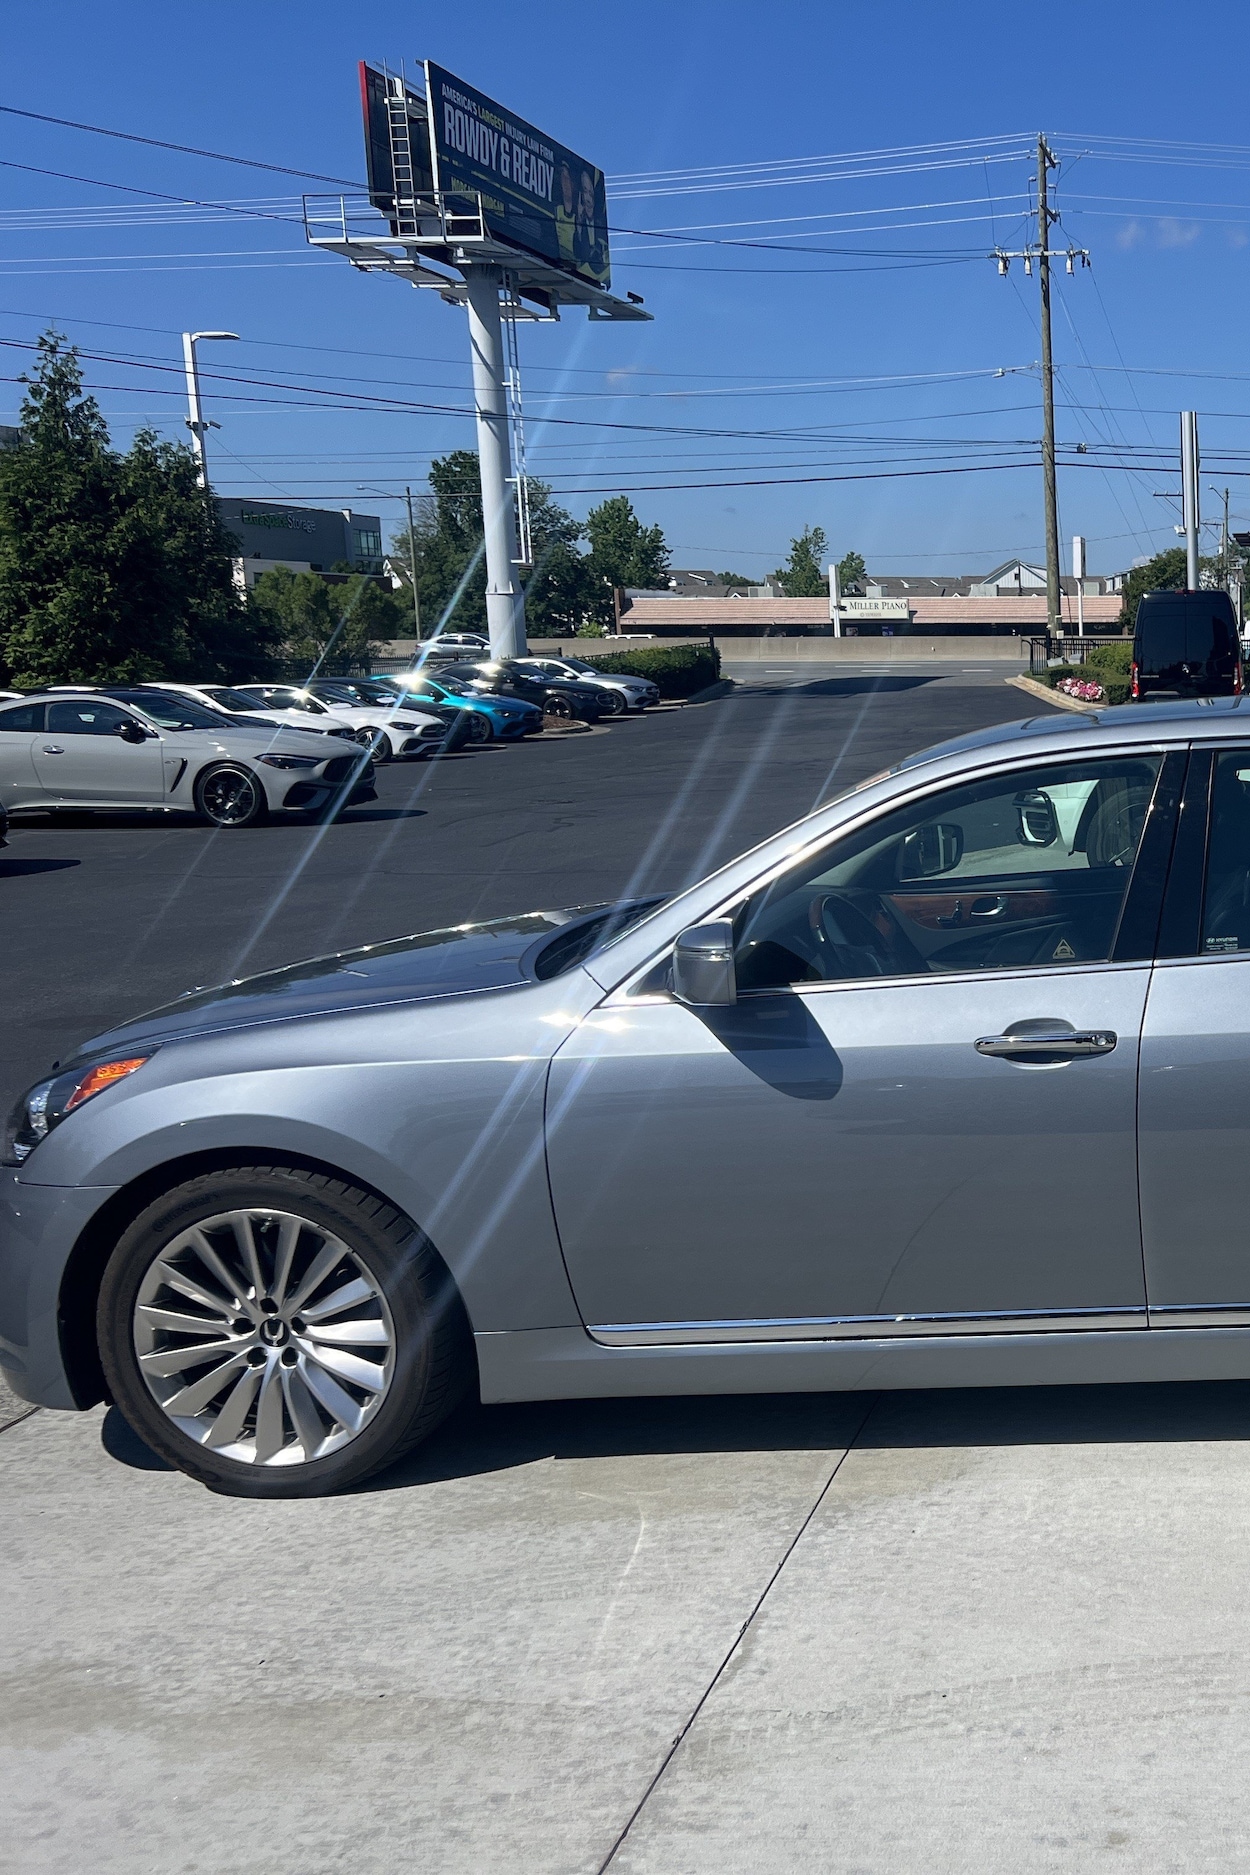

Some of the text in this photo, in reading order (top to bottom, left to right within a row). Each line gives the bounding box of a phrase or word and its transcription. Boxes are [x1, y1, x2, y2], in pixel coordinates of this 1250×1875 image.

[441, 82, 478, 117] AMERICA'S
[477, 104, 505, 133] LARGEST
[505, 121, 527, 146] INJURY
[526, 135, 540, 155] LAW
[443, 102, 555, 202] ROWDY & READY
[881, 601, 907, 610] PIANO
